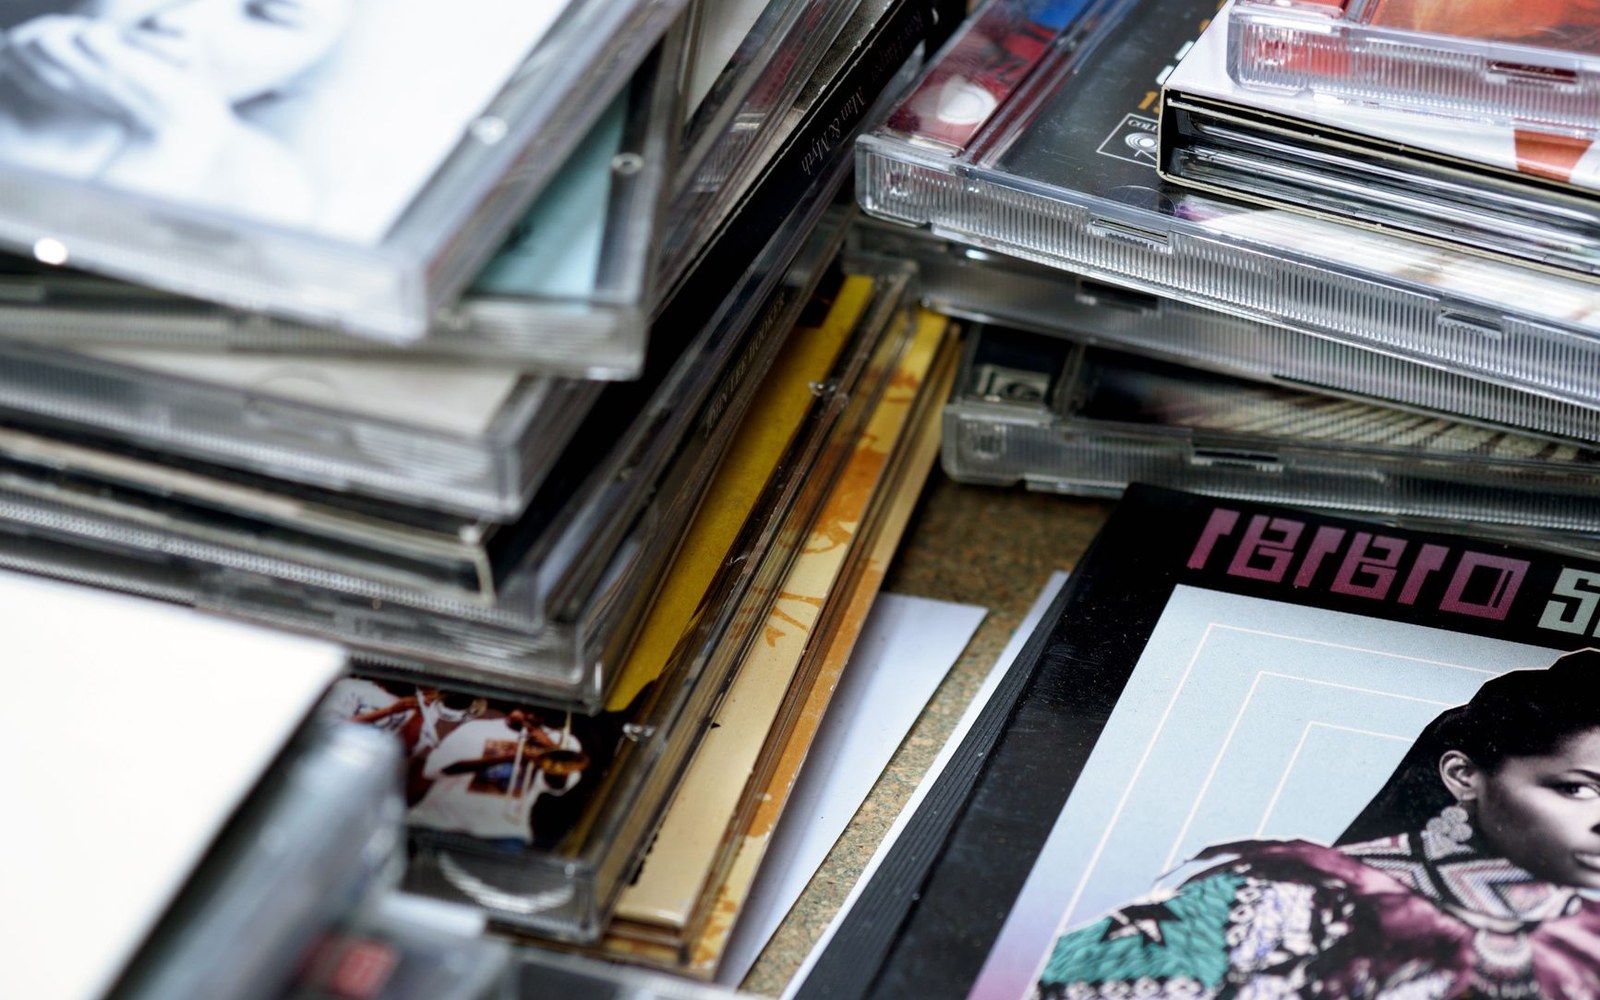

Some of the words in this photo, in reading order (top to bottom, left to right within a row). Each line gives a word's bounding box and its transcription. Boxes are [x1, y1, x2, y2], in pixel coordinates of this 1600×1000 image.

[840, 86, 865, 120] Man
[828, 117, 841, 139] &
[801, 130, 831, 176] Myth
[1537, 567, 1600, 638] S
